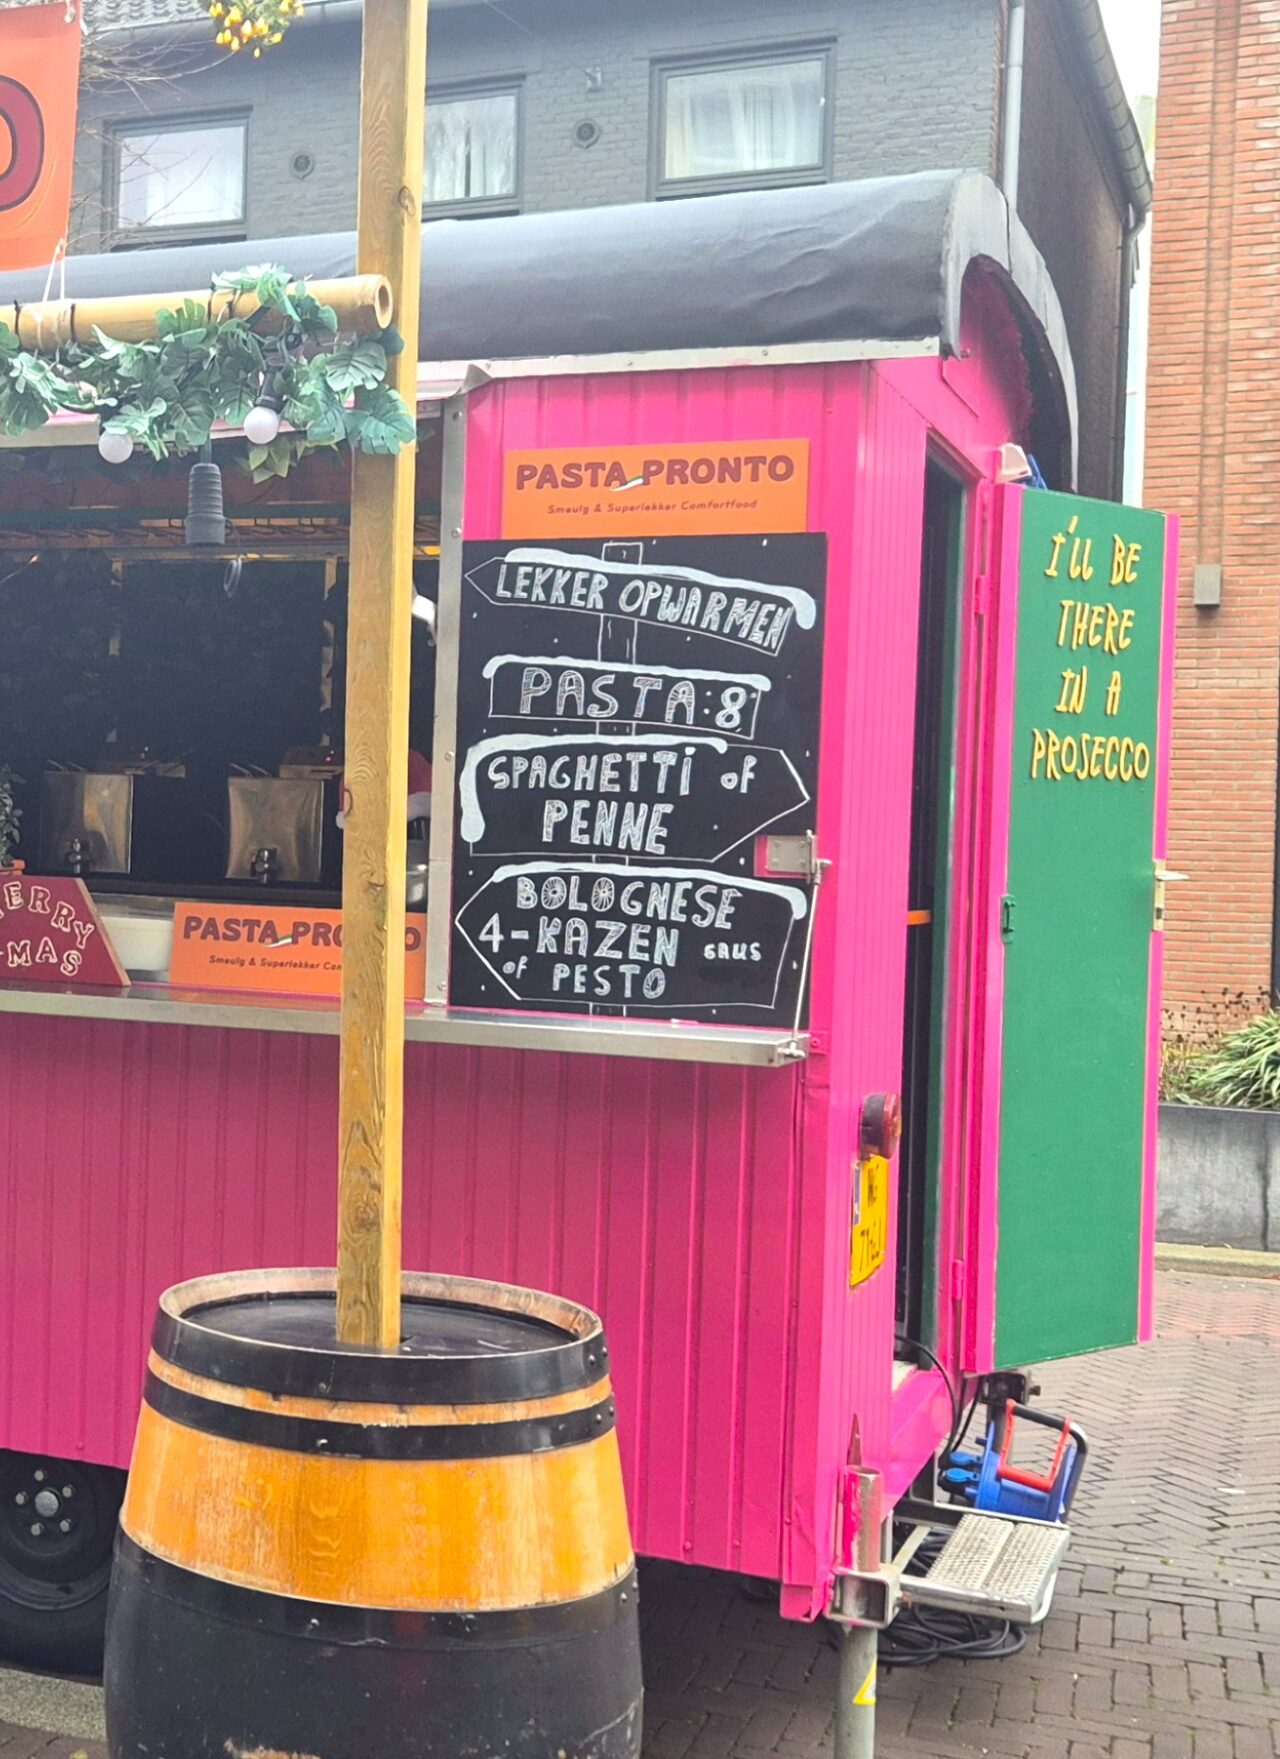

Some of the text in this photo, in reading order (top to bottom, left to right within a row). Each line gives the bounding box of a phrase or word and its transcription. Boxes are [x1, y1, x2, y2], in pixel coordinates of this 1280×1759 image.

[515, 455, 795, 490] PASTA PRONTO
[680, 500, 758, 511] Comfortfood
[1109, 533, 1142, 586] BE
[495, 563, 794, 651] LEKKER OPWARMEN
[1056, 600, 1135, 655] THERE
[1055, 666, 1121, 715] IN A
[1031, 728, 1150, 782] PROSECCO
[541, 799, 674, 855] PENNE
[515, 875, 743, 930] BOLOGNESE
[183, 916, 421, 951] PASTA PRO
[552, 963, 666, 999] PESTO
